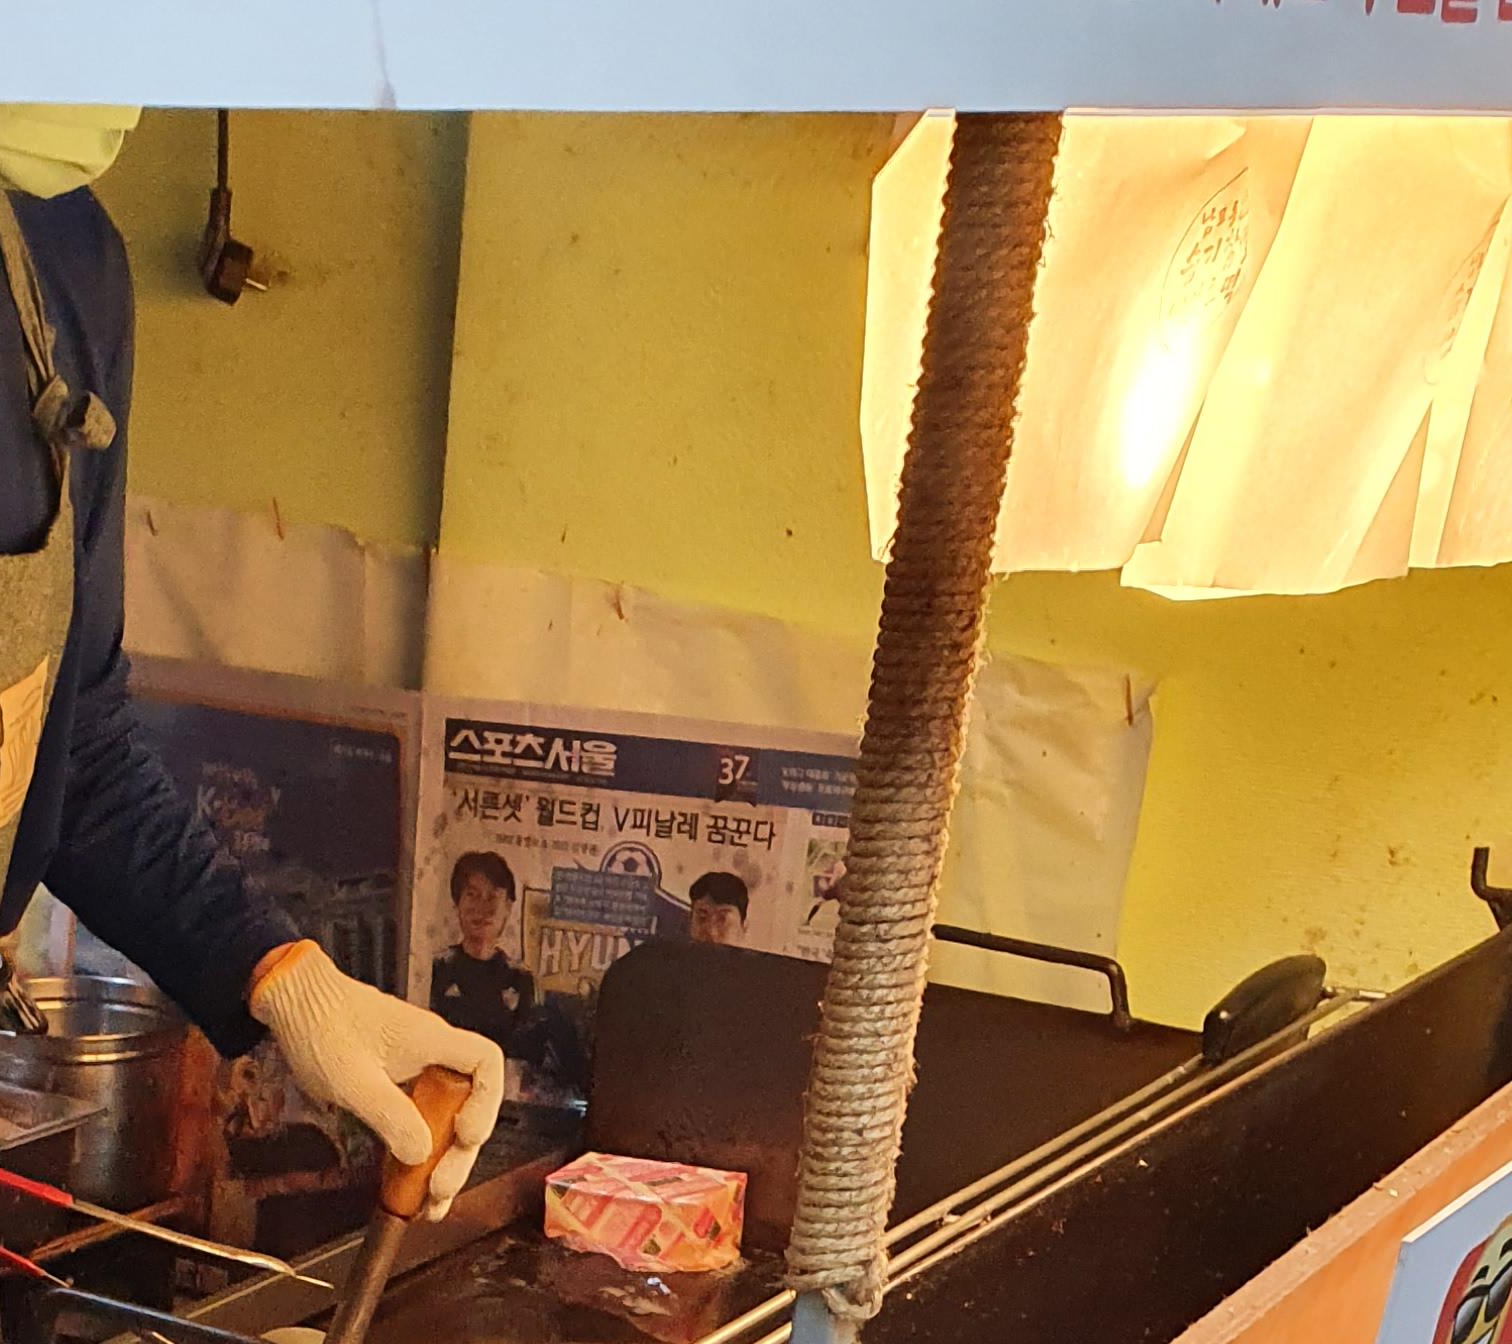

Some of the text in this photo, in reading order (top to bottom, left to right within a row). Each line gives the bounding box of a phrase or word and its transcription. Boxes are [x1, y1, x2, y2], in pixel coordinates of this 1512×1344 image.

[448, 727, 618, 778] 스포츠서울
[719, 755, 750, 786] 37
[536, 796, 602, 832] 월드컵
[614, 804, 698, 842] V피날레
[706, 813, 776, 851] 꿈꾼다
